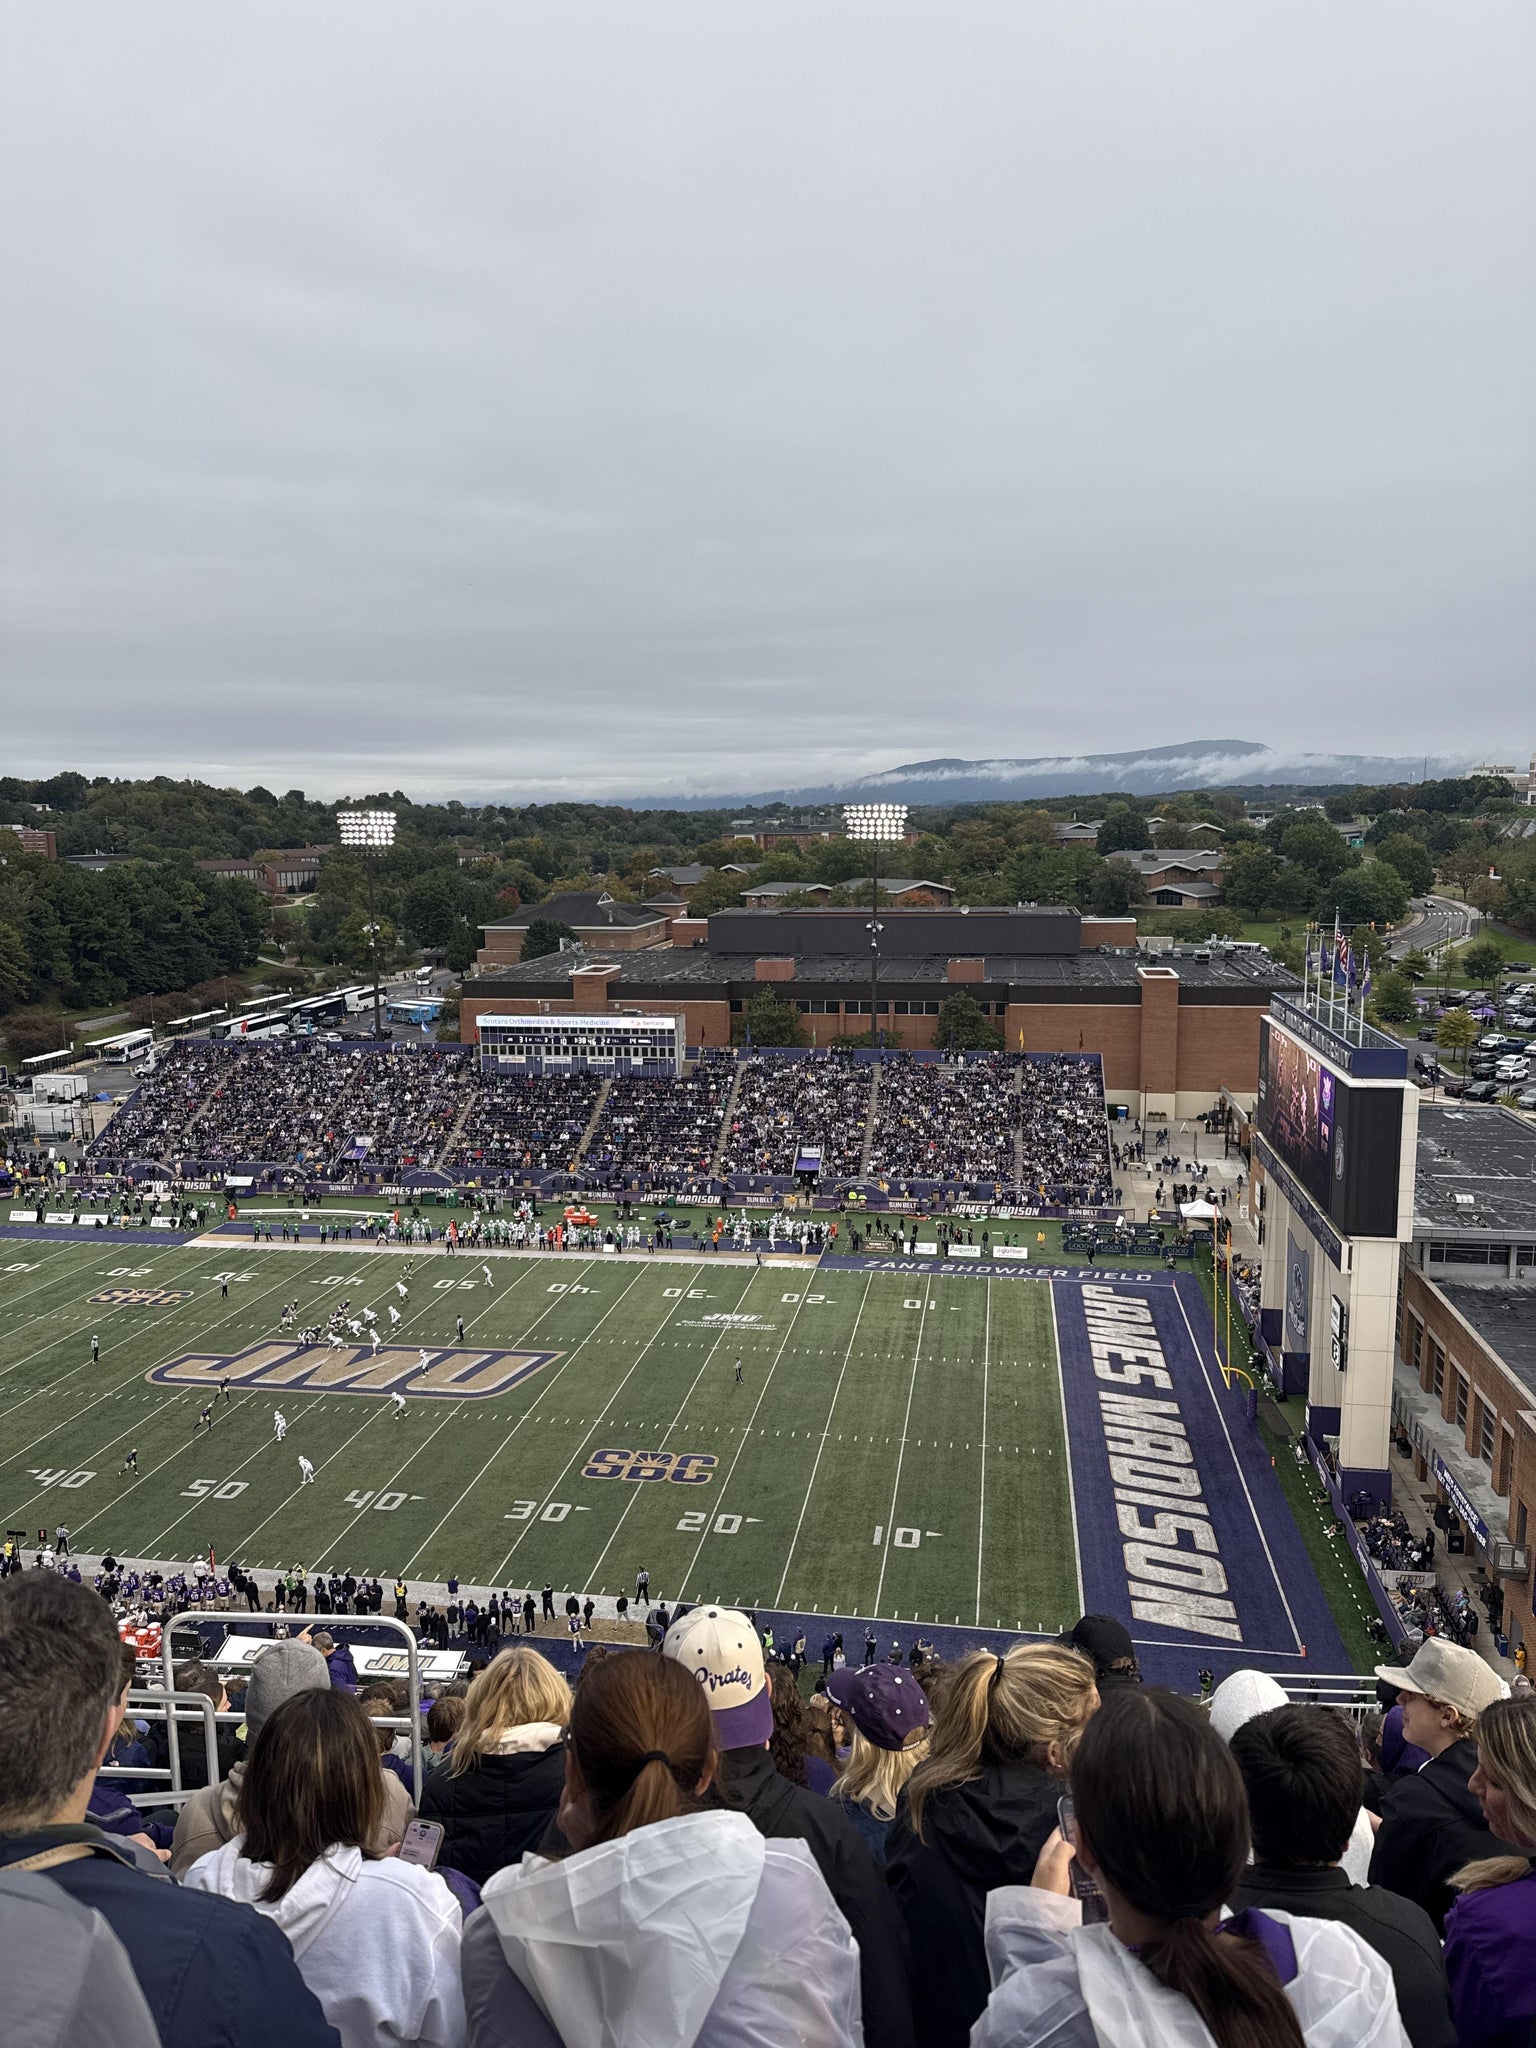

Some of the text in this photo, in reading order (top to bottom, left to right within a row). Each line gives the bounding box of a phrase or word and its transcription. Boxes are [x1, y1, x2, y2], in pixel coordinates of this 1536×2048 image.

[509, 1018, 549, 1026] Orthopedics
[556, 1019, 578, 1027] Sports
[170, 1181, 211, 1190] MDISON
[379, 1187, 410, 1195] JAMES
[677, 1195, 721, 1204] MADISON
[952, 1204, 1040, 1216] JAMES MADISON
[950, 1245, 977, 1253] Augusta
[864, 1260, 1152, 1282] ZANE SHOWKER FIELD
[87, 1287, 194, 1307] SBC
[702, 1313, 763, 1322] JMU
[1081, 1284, 1174, 1390] JAMES
[145, 1339, 568, 1401] JMU
[580, 1448, 719, 1486] SBC
[34, 1469, 98, 1489] 40
[179, 1479, 250, 1500] 50
[343, 1489, 408, 1511] 40
[503, 1500, 572, 1522] 30
[1098, 1390, 1243, 1643] MADISON
[675, 1511, 743, 1534] 20
[872, 1525, 921, 1549] 10
[365, 1652, 437, 1671] JMU
[694, 1665, 752, 1692] Pirates
